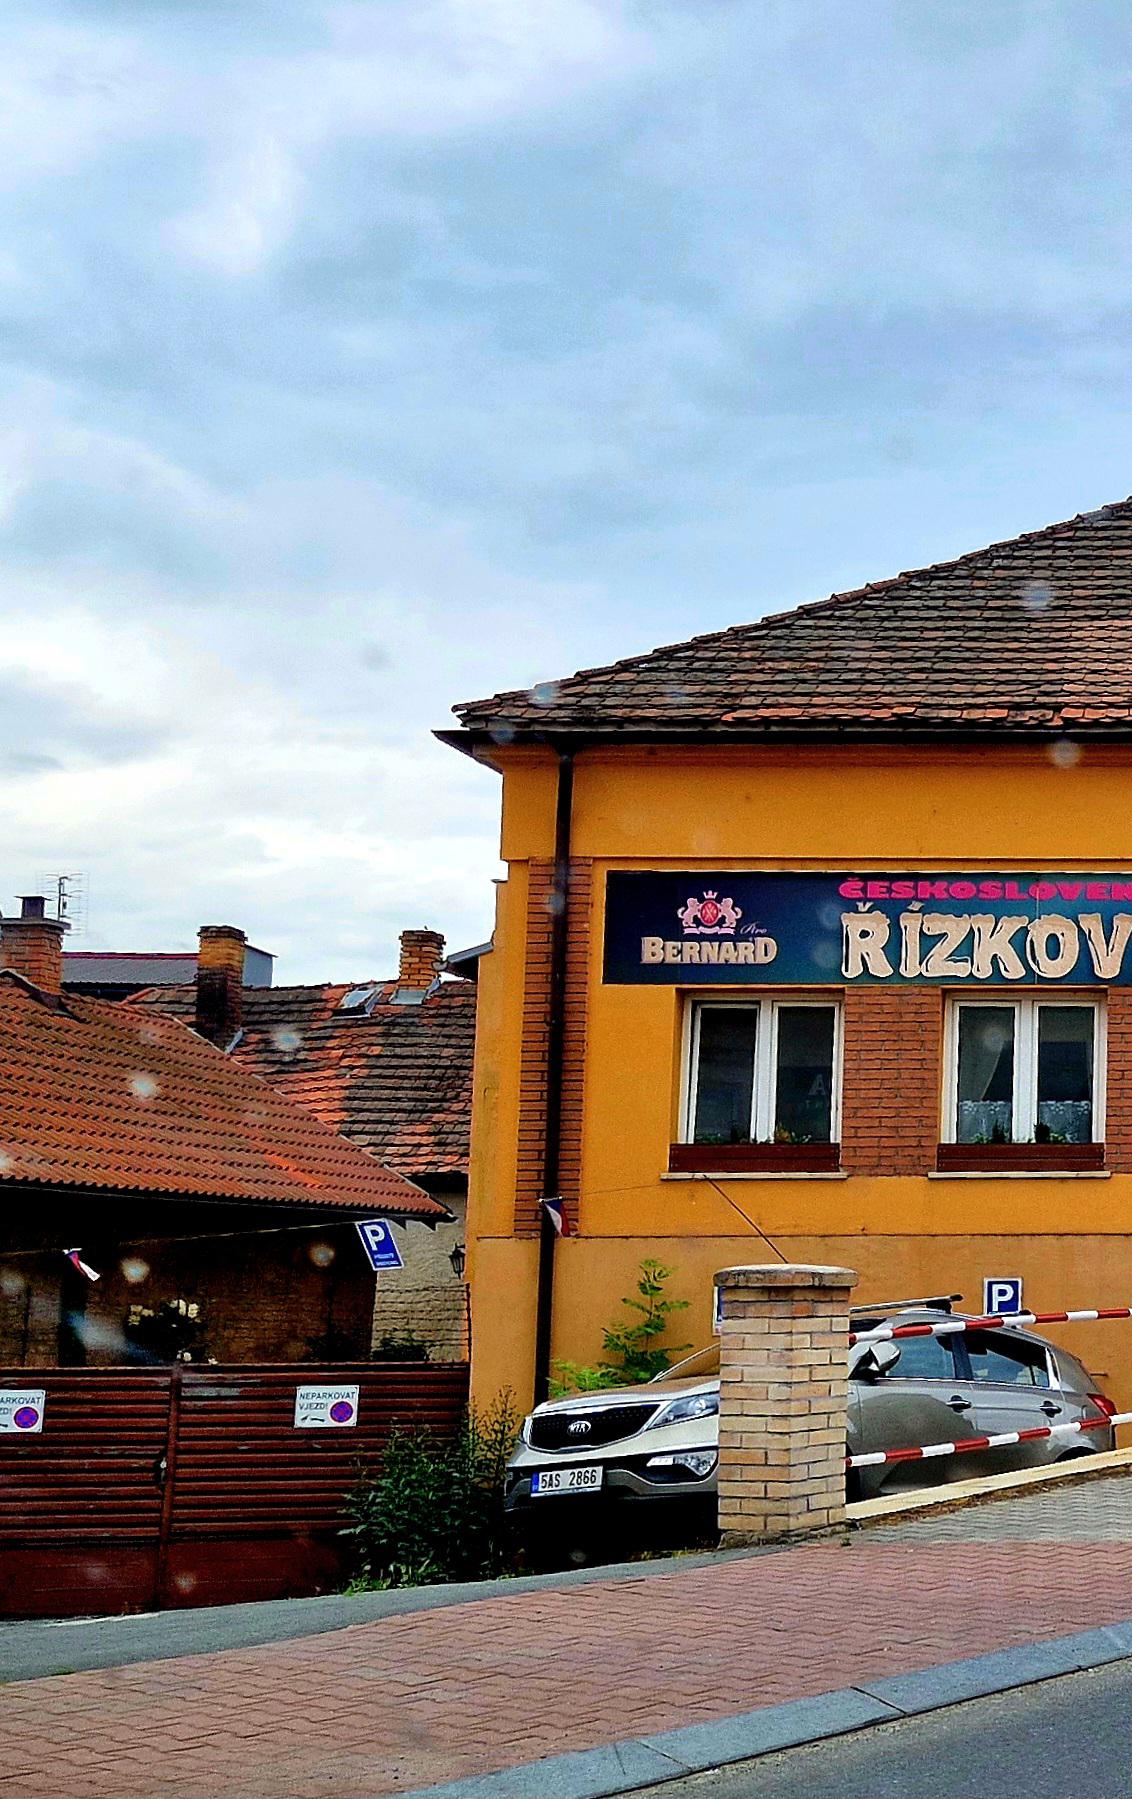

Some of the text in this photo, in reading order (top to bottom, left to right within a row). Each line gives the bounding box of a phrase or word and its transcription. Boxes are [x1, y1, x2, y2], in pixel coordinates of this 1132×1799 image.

[640, 936, 778, 964] BERNARD
[363, 1224, 385, 1251] P
[992, 1284, 1014, 1312] P
[300, 1391, 356, 1400] NEPARKOVAT
[541, 1469, 597, 1489] 5AS 2866
